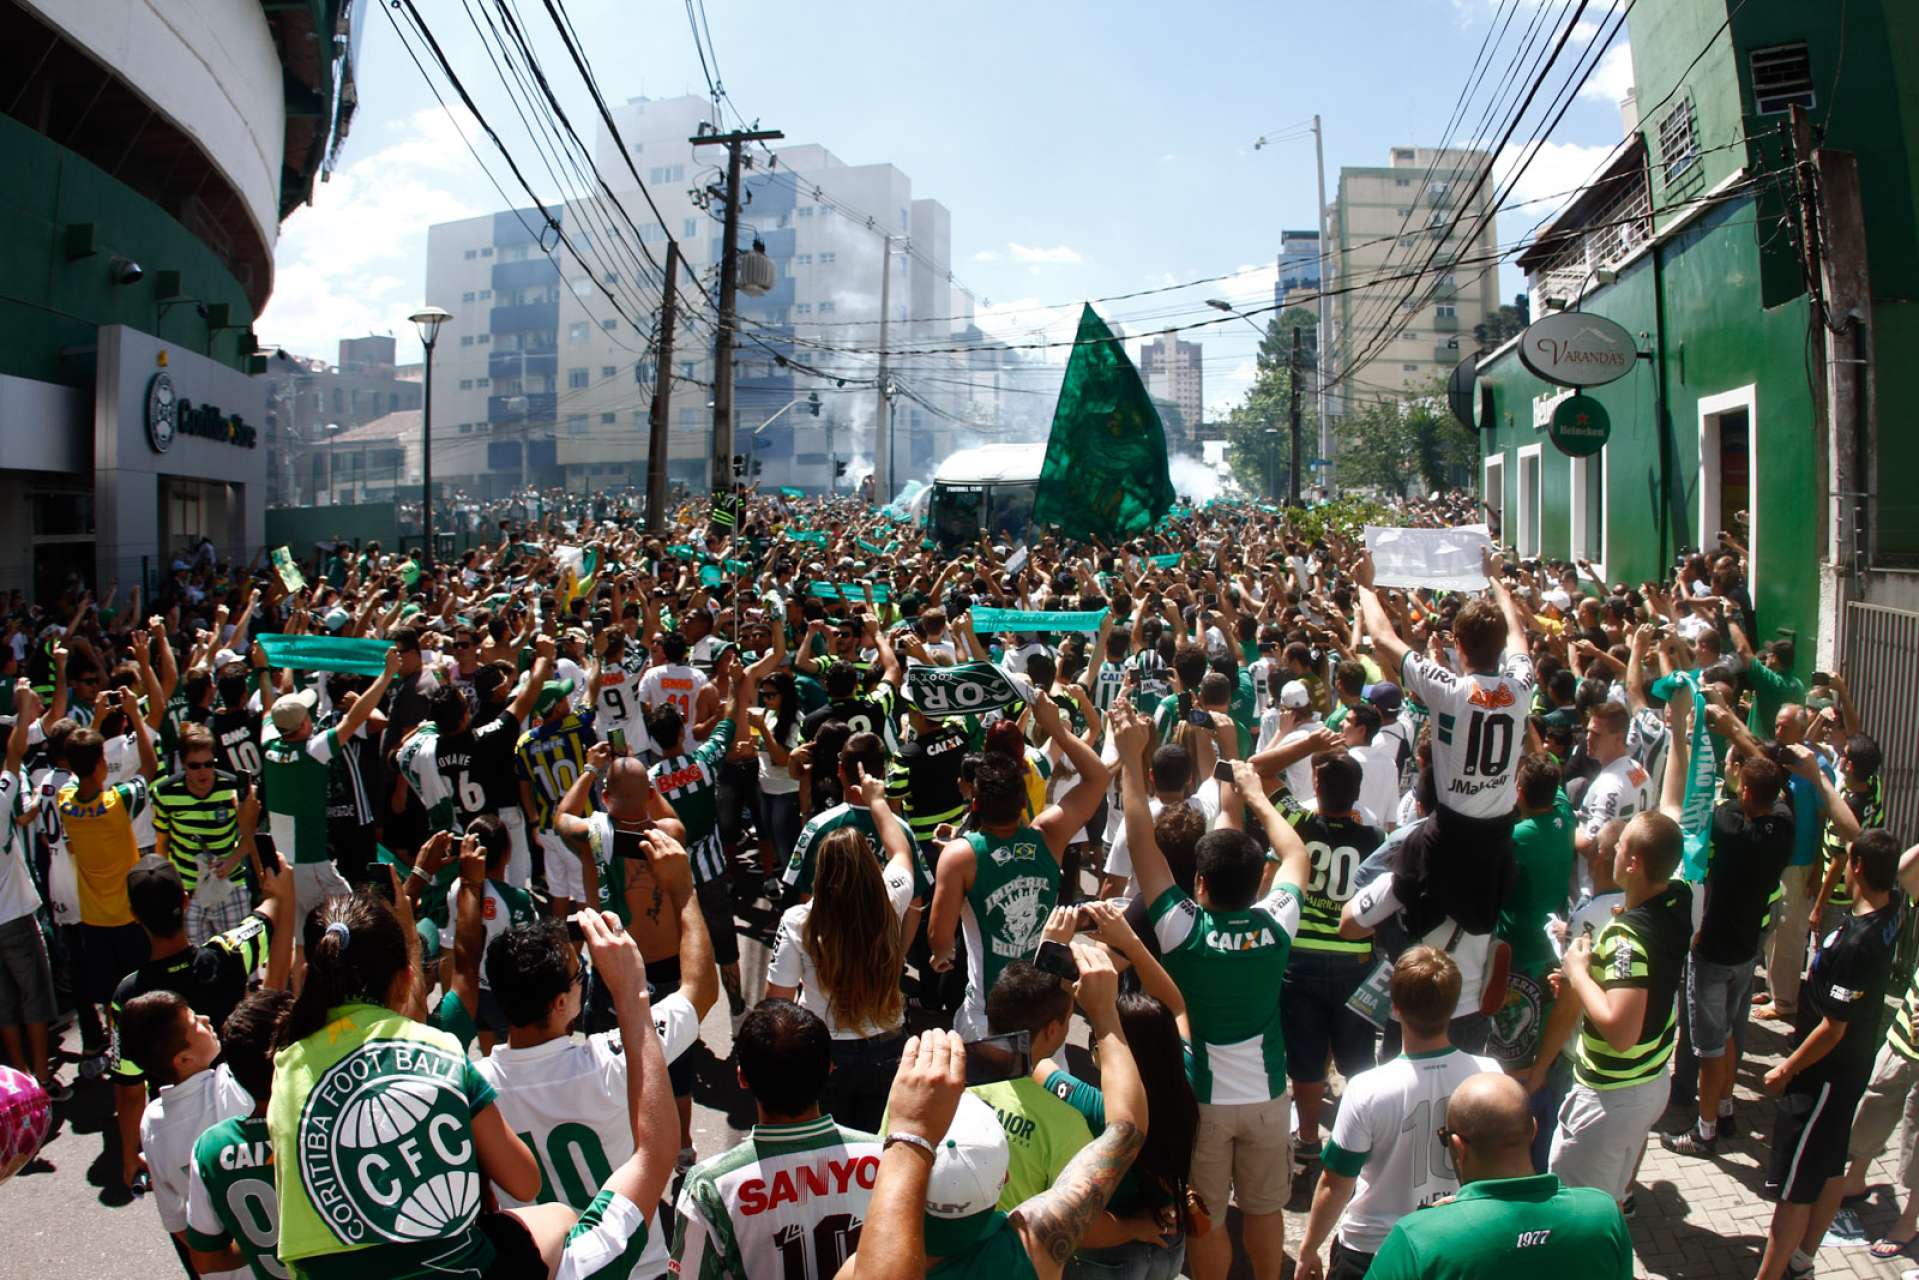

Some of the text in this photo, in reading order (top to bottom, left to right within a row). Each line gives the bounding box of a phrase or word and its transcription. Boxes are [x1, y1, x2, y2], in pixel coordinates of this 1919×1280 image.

[1560, 425, 1605, 437] Heineken
[603, 688, 627, 720] 9
[220, 726, 251, 746] BMG
[926, 735, 964, 757] CAIXA
[1463, 710, 1515, 777] 10
[225, 741, 262, 776] 10
[533, 758, 579, 801] 10
[656, 762, 704, 794] BMG
[1206, 928, 1276, 951] CAIXA
[989, 1104, 1037, 1141] AIOR
[307, 1049, 460, 1240] CORITIBA FOOT BALL
[357, 1112, 473, 1207] CFC
[738, 1154, 881, 1216] SANYO
[773, 1213, 865, 1280] 10
[1516, 1229, 1551, 1249] 1977
